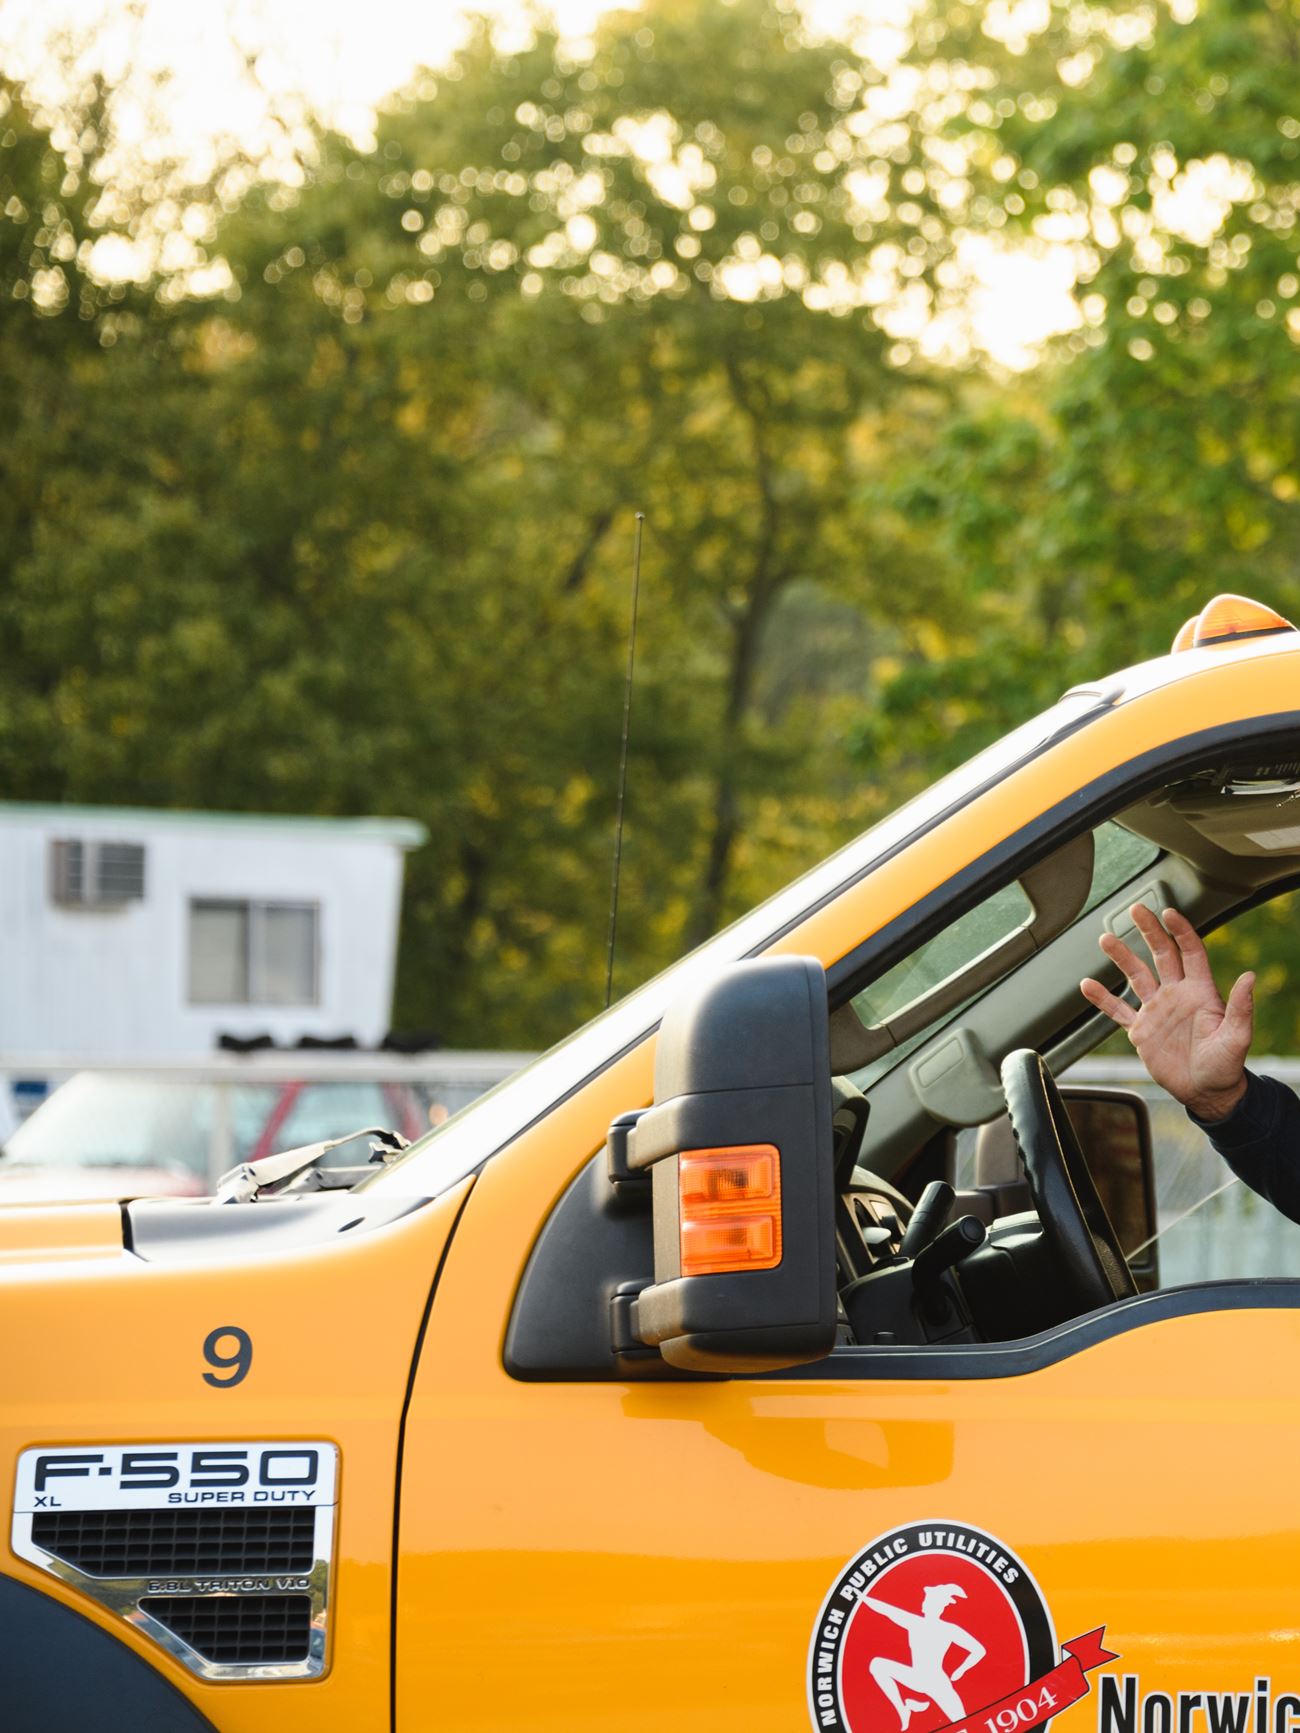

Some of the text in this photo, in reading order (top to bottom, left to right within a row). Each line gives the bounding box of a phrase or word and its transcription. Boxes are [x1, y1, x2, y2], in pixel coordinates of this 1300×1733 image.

[202, 1326, 253, 1388] 9
[34, 1450, 318, 1491] F-550
[34, 1496, 62, 1507] XL
[168, 1490, 316, 1504] SUPER DUTY
[148, 1578, 311, 1593] 6.8L TRITON V10
[817, 1531, 1019, 1726] NORWICH PUBLIC UTILITIES
[984, 1686, 1058, 1733] 1904
